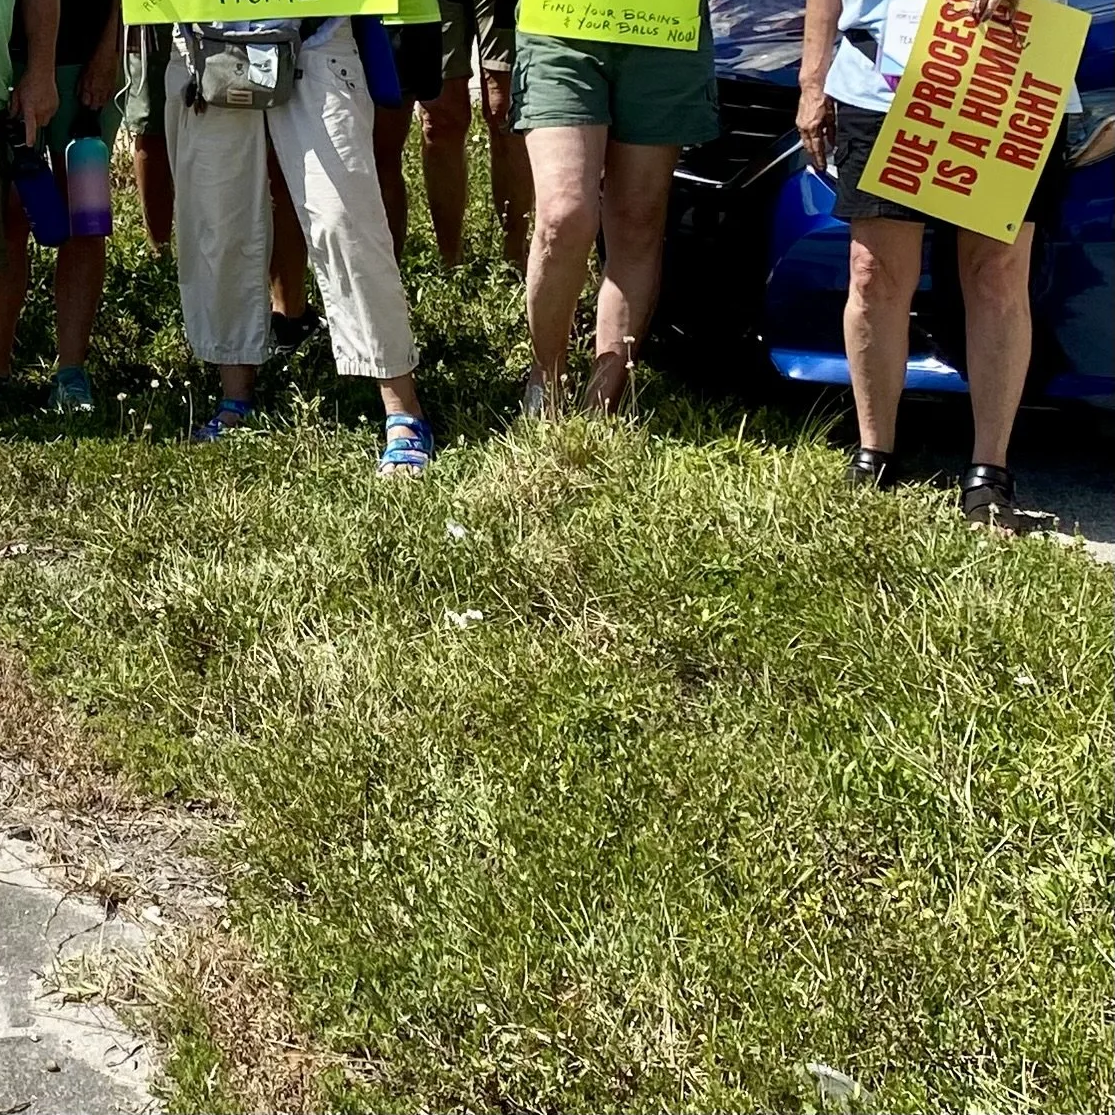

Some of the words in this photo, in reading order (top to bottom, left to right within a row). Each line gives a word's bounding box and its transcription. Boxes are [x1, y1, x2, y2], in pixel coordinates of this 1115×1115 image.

[542, 0, 574, 14] FIND
[584, 3, 616, 20] YOUR
[621, 9, 680, 25] BRAINS
[577, 17, 611, 30] YOUR
[616, 21, 659, 36] BALLS
[666, 26, 697, 42] NOW
[995, 71, 1063, 171] RIGHT
[948, 130, 992, 159] A
[877, 129, 938, 196] DUE
[931, 159, 979, 197] IS
